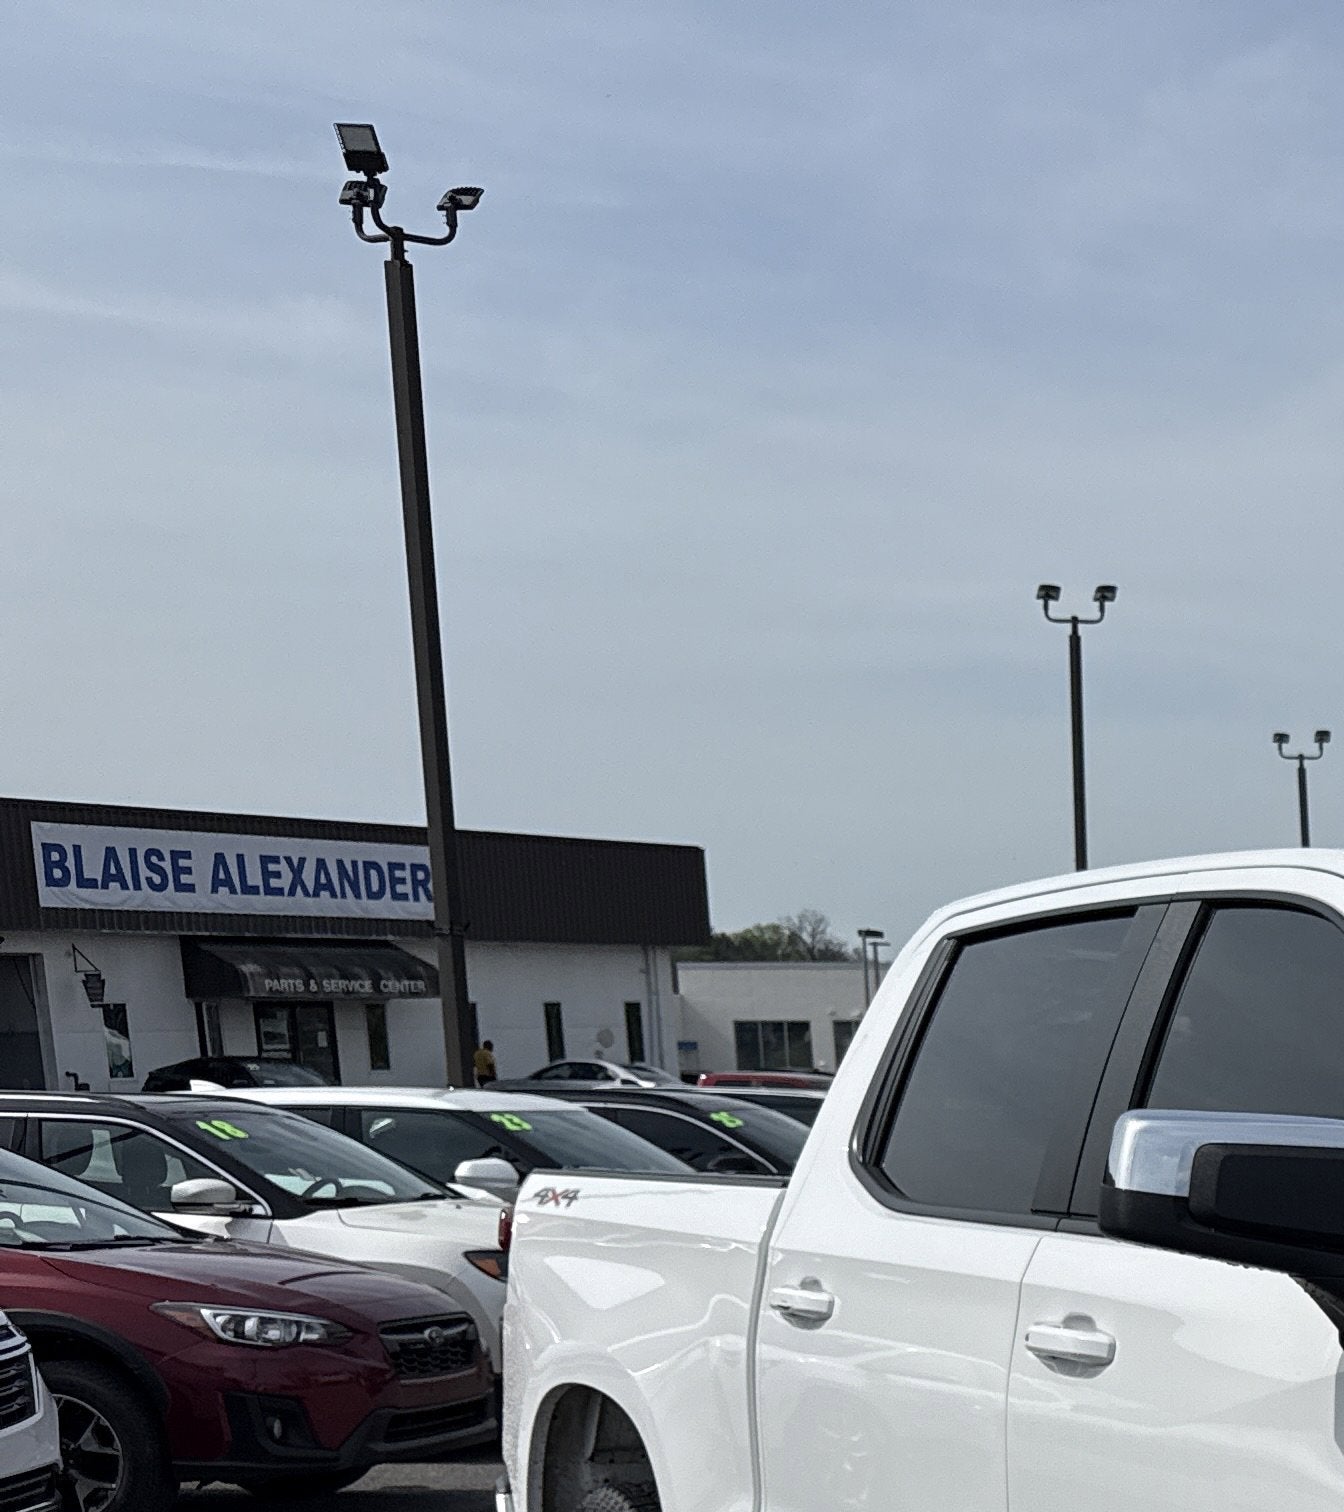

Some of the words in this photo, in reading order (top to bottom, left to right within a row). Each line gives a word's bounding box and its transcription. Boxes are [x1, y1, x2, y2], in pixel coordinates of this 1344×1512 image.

[41, 842, 196, 894] BLAISE
[210, 852, 433, 903] ALEXANDER
[264, 979, 305, 993] PARTS
[309, 980, 318, 993] &
[322, 979, 374, 994] SERVICE
[380, 979, 427, 994] CENTER
[195, 1120, 249, 1140] 18
